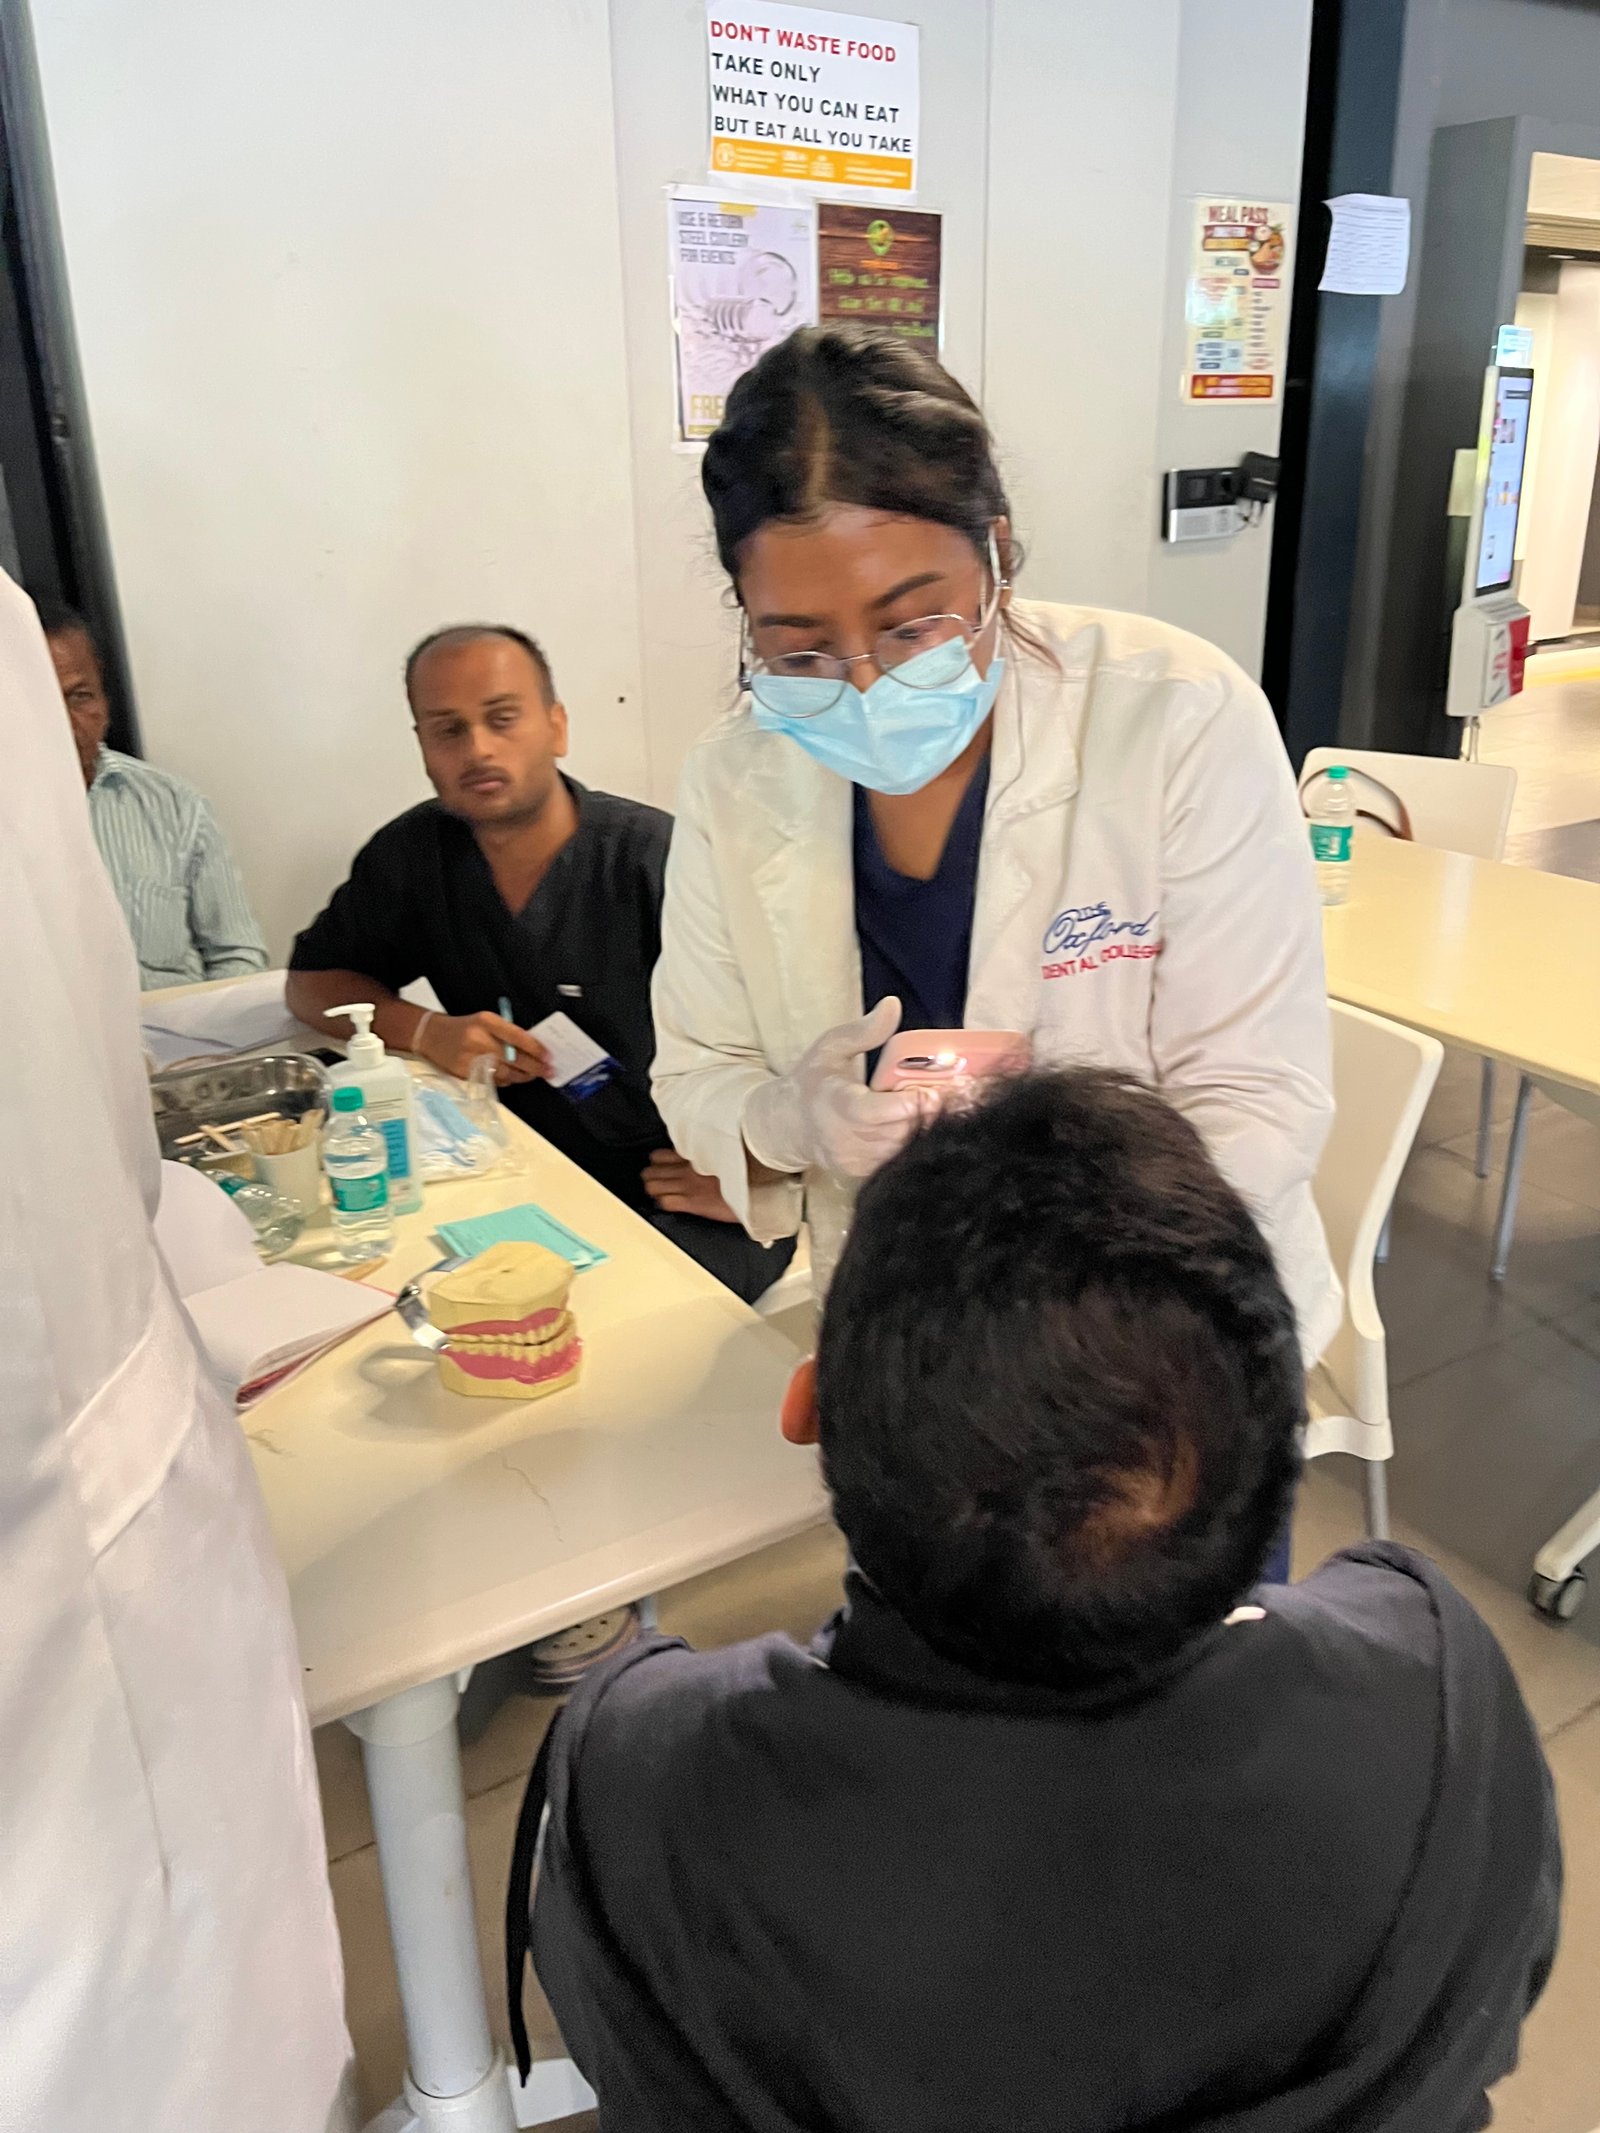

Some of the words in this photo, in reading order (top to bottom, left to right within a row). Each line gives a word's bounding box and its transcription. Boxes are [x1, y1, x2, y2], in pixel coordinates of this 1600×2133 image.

[710, 20, 770, 44] DON'T
[777, 29, 841, 55] WASTE
[847, 41, 897, 63] FOOD
[712, 52, 764, 76] TAKE
[771, 61, 821, 83] ONLY
[713, 84, 768, 108] WHAT
[775, 93, 814, 114] YOU
[820, 99, 858, 120] CAN
[865, 104, 900, 124] EAT
[714, 116, 749, 135] BUT
[755, 121, 787, 140] EAT
[792, 126, 823, 144] ALL
[827, 130, 863, 148] YOU
[869, 135, 912, 153] TAKE
[1208, 206, 1239, 223] MEAL
[1241, 206, 1269, 224] PASS
[690, 394, 725, 420] FRE
